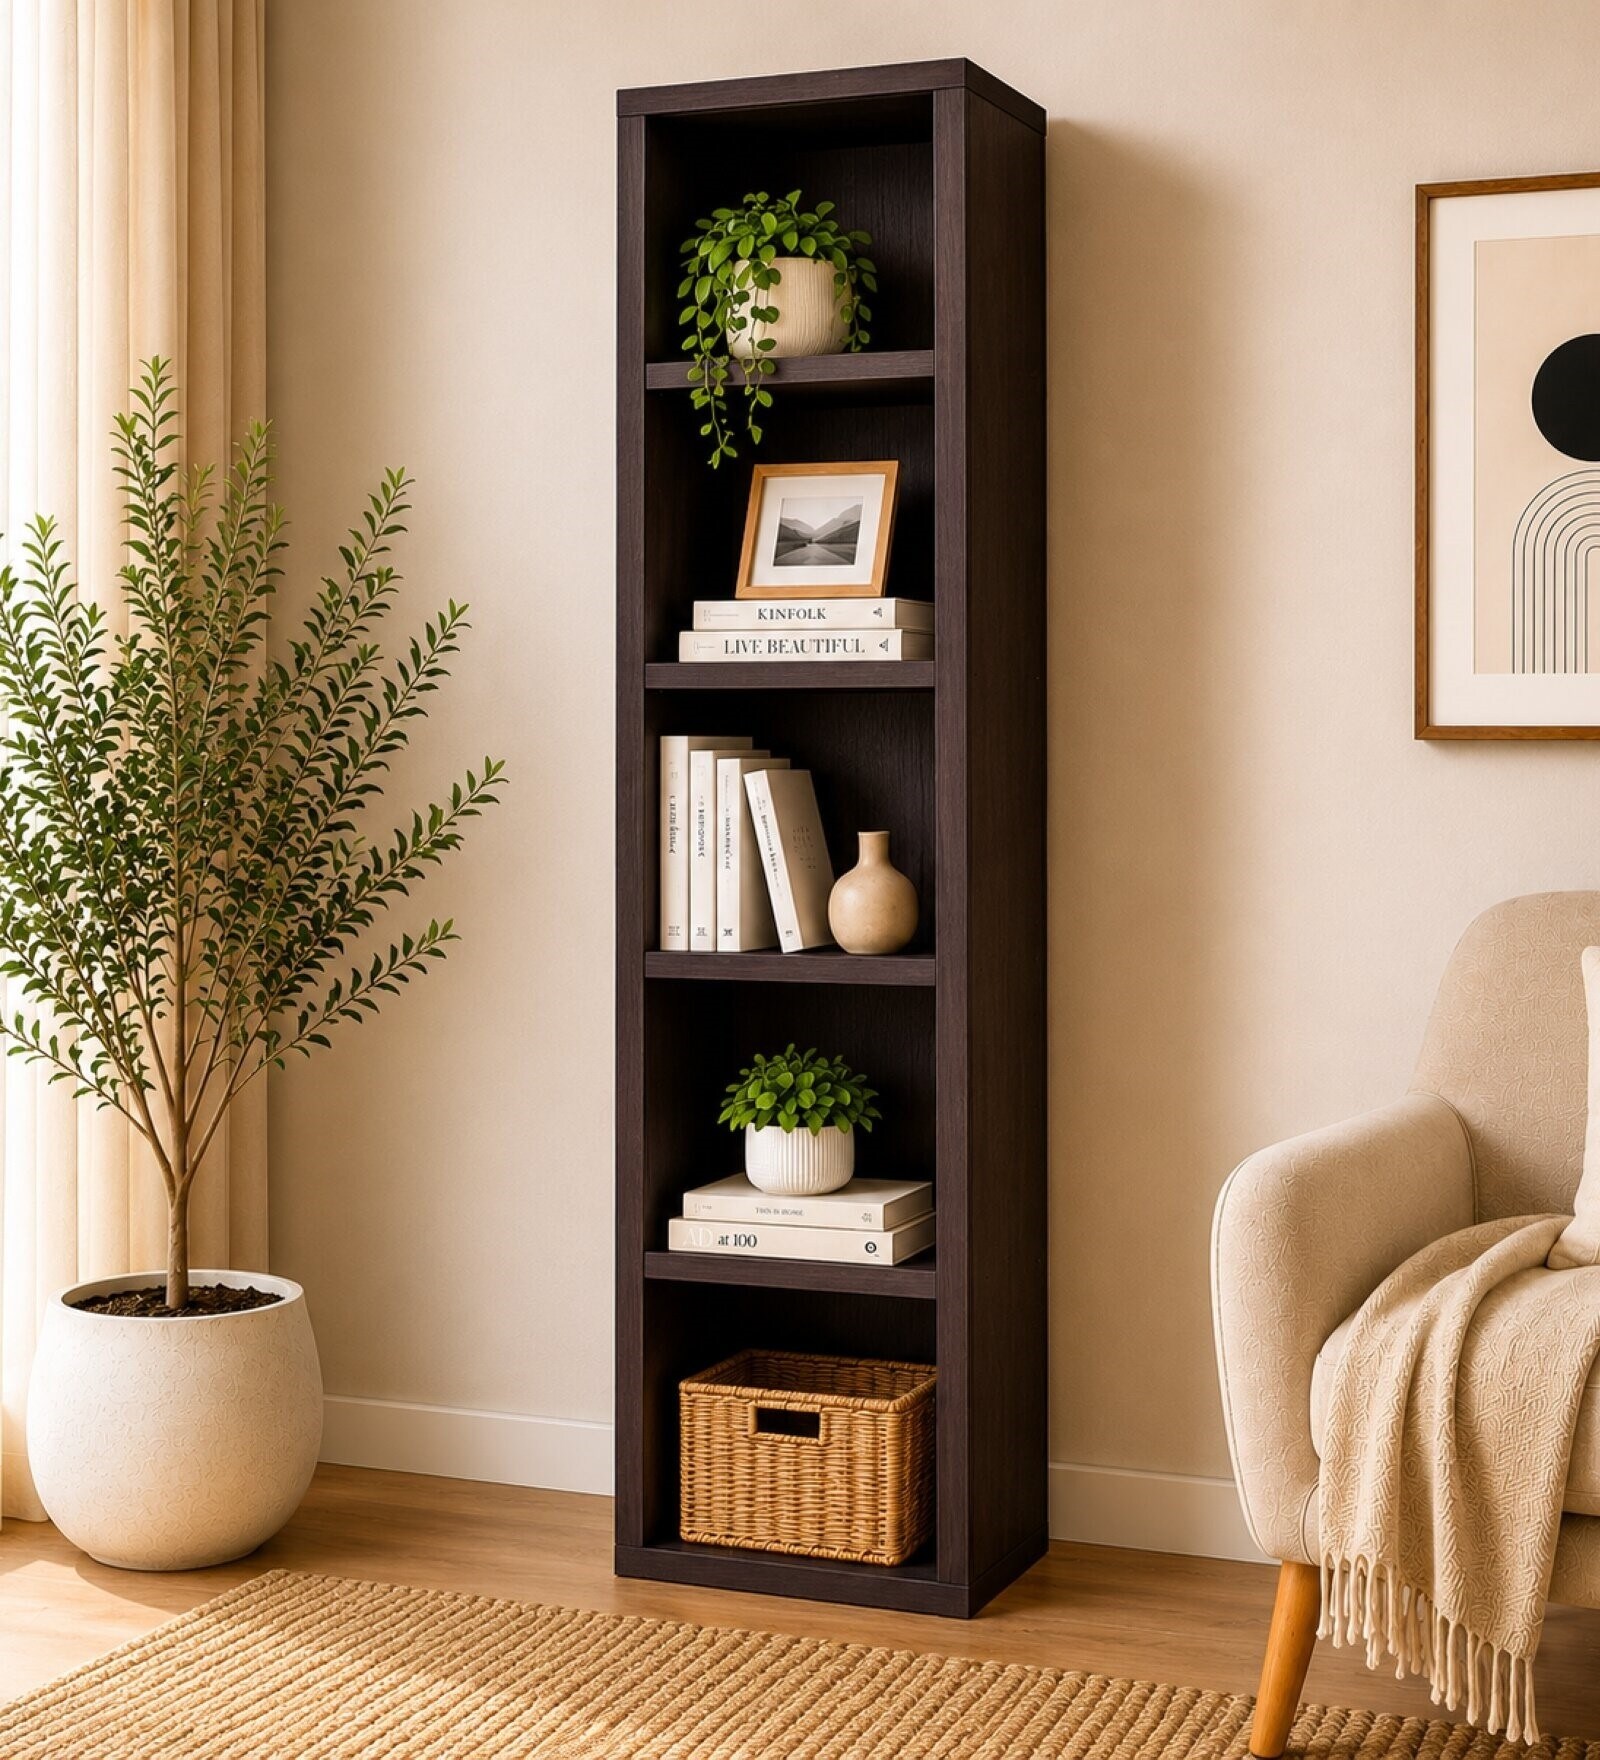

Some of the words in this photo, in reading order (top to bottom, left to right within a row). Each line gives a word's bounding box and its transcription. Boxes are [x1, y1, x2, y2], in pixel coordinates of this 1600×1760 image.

[757, 608, 827, 620] KINFOLK
[724, 639, 763, 655] LIVE
[767, 638, 866, 654] BEAUTIFUL
[682, 1226, 714, 1248] AD
[718, 1234, 730, 1246] at
[734, 1233, 758, 1248] 100
